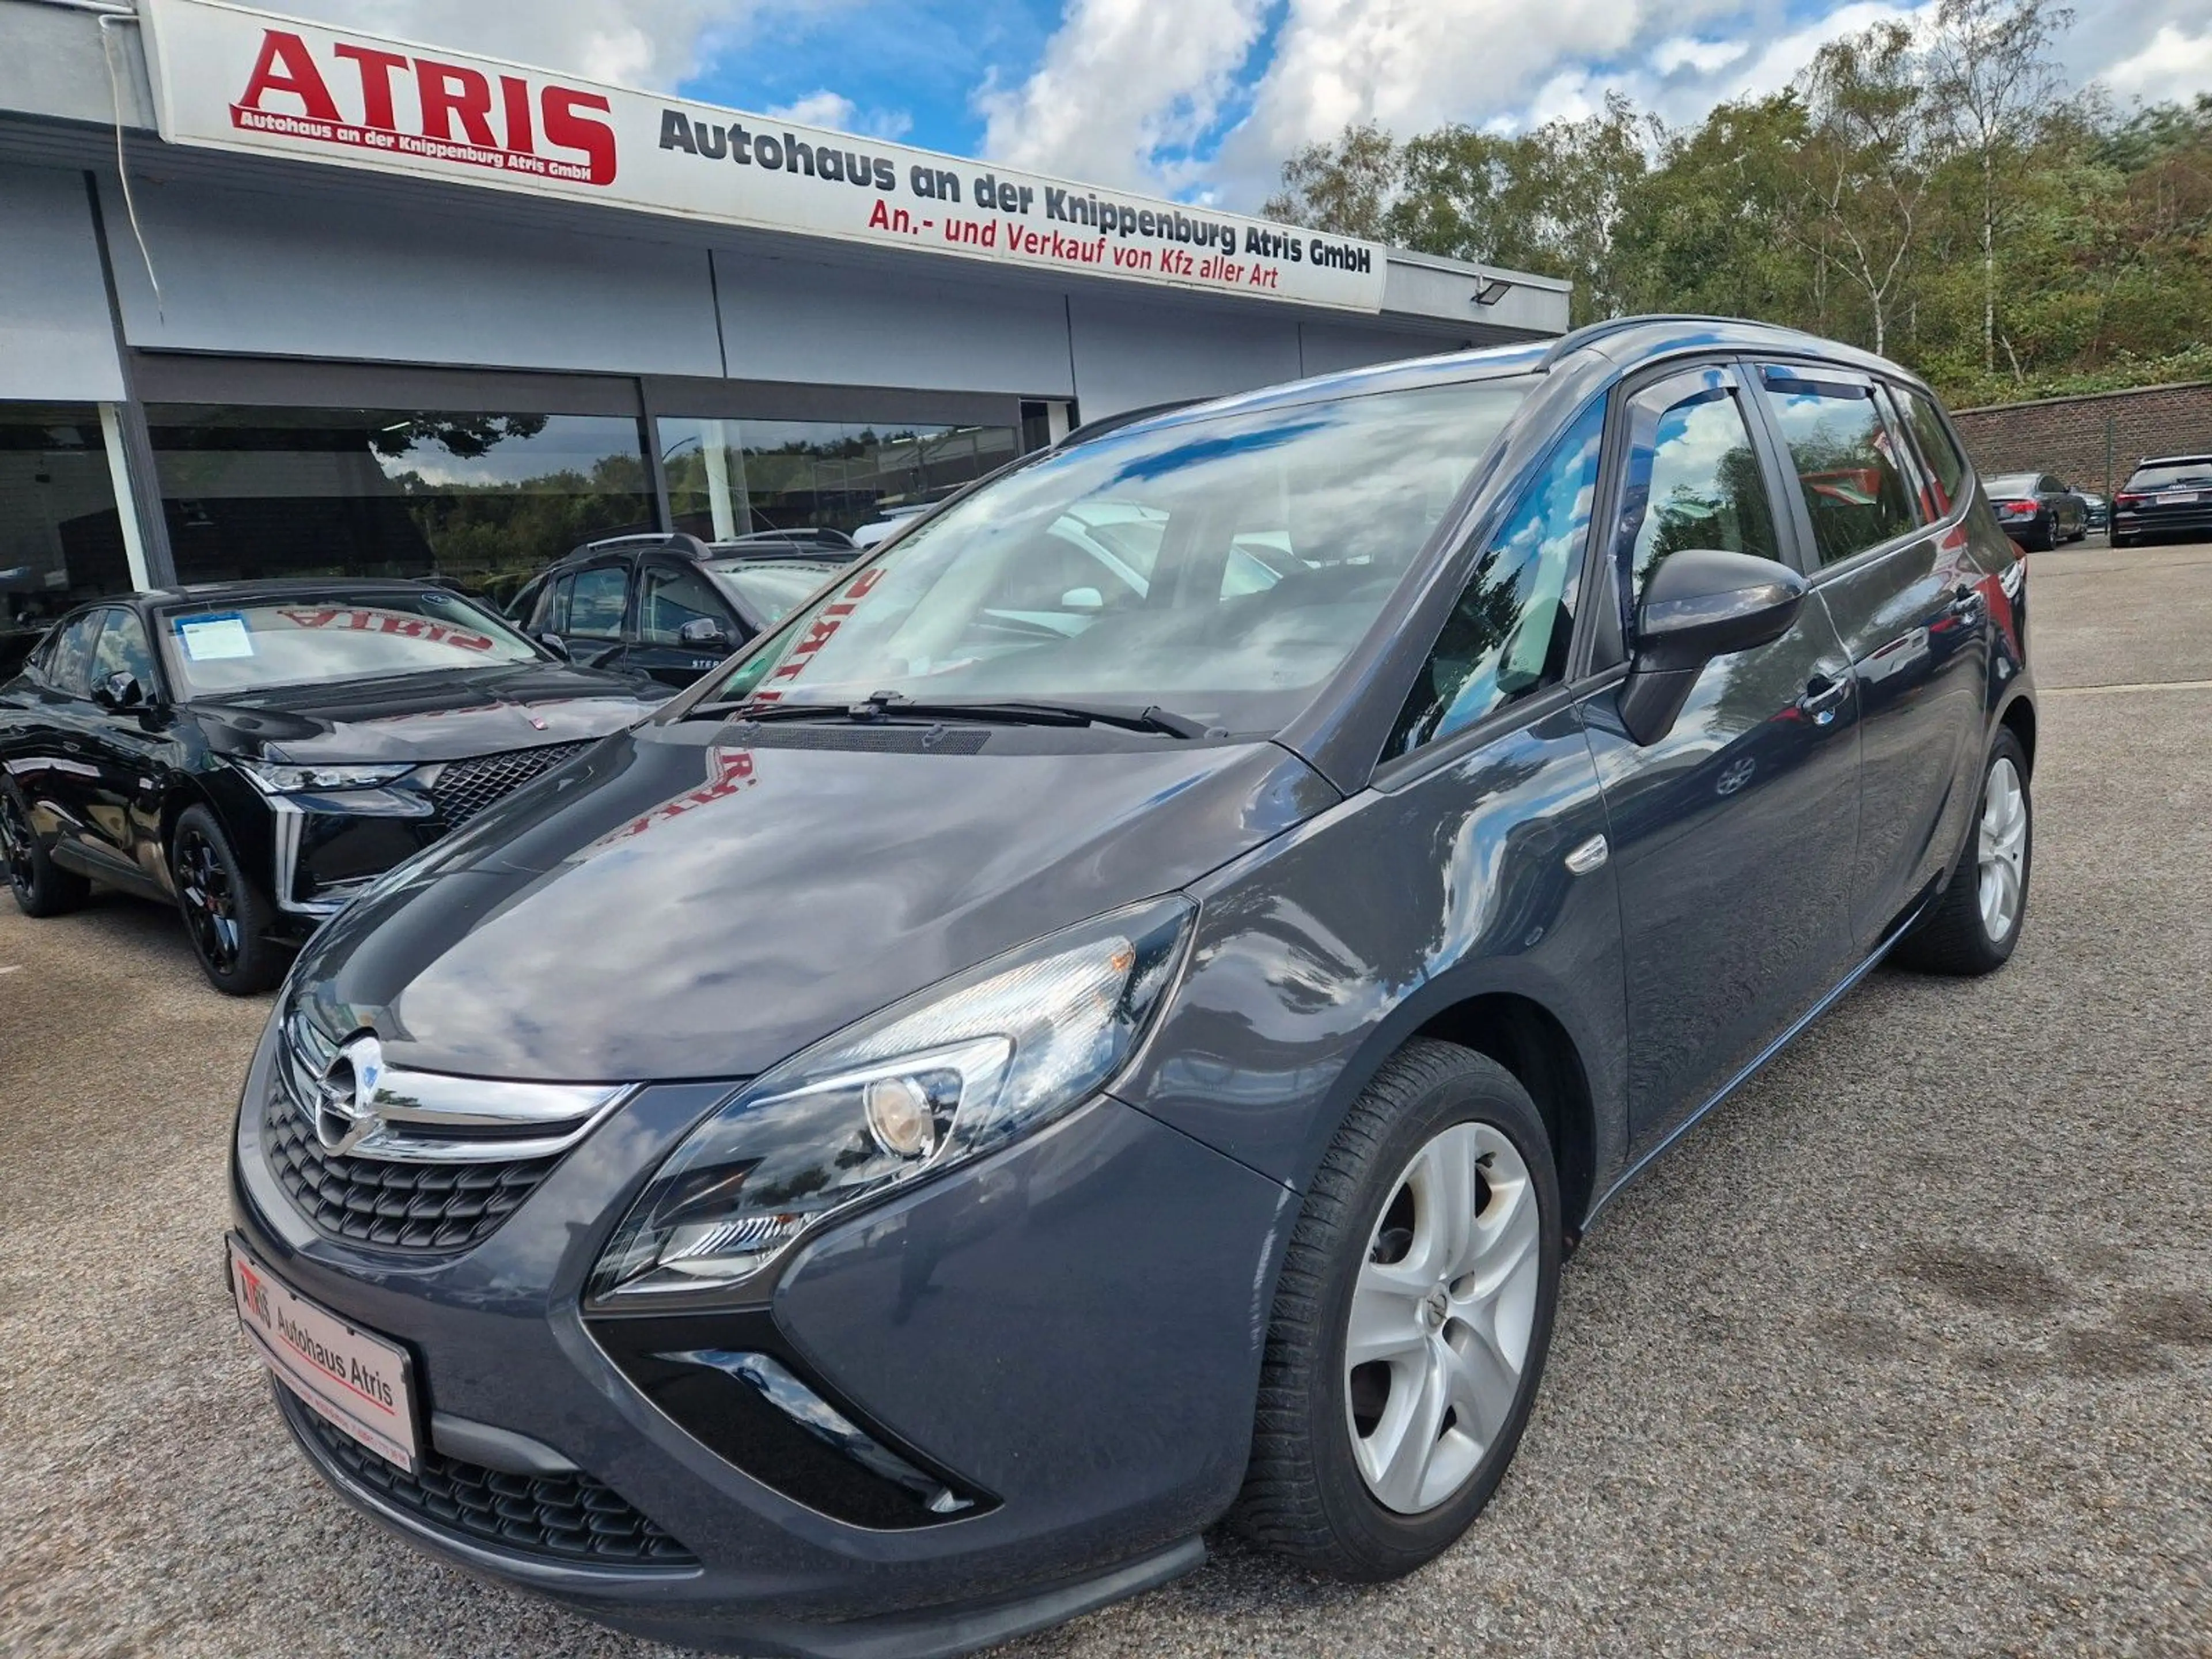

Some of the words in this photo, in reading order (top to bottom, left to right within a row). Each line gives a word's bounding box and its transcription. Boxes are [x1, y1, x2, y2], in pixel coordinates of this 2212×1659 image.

[238, 28, 616, 185] ATRIS
[240, 112, 331, 138] Autohaus
[338, 131, 360, 143] an
[365, 133, 395, 148] der
[399, 136, 503, 167] Knippenburg
[508, 155, 544, 173] Atris
[550, 163, 591, 180] GmbH
[659, 109, 895, 191] Autohaus
[910, 165, 960, 202] an
[974, 174, 1033, 214] der
[1045, 187, 1236, 255] Knippenburg
[1245, 227, 1302, 262] Atris
[1310, 240, 1371, 273] GmbH
[945, 218, 997, 247] und
[1007, 223, 1105, 263] Verkauf
[1113, 247, 1151, 268] von
[1160, 249, 1194, 275] Kfz
[1200, 256, 1244, 282] aller
[1249, 263, 1278, 288] Art
[278, 1306, 346, 1378] Autohaus
[351, 1357, 393, 1406] Atris
